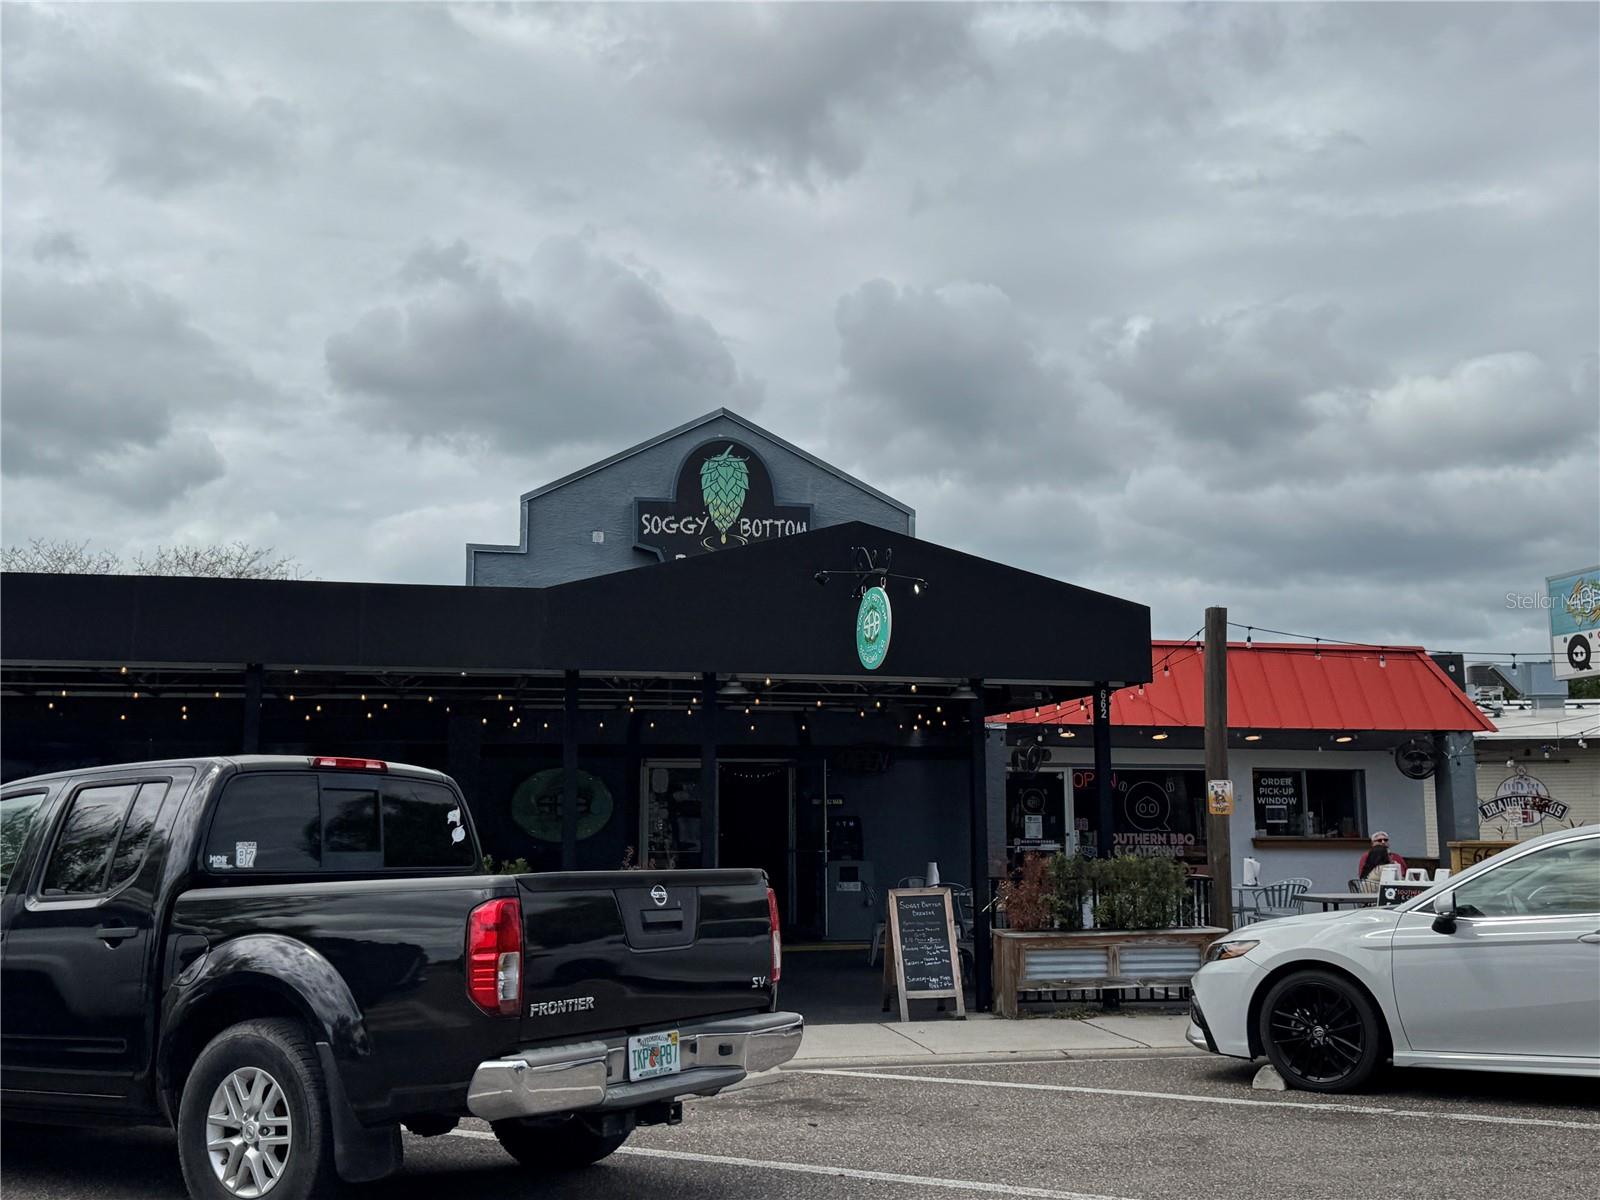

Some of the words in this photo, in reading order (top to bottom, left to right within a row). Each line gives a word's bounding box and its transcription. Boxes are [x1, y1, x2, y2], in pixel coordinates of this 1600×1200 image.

[641, 514, 709, 535] SOGGY
[739, 518, 807, 538] BOTTOM
[1073, 772, 1118, 789] OPN
[1260, 777, 1292, 786] ORDER
[1259, 787, 1295, 796] PICK-UP
[1257, 796, 1297, 805] WINDOW
[1113, 832, 1167, 845] OUTHERN
[1170, 832, 1196, 845] BBQ
[752, 976, 766, 988] SV
[530, 996, 595, 1017] FRONTIER
